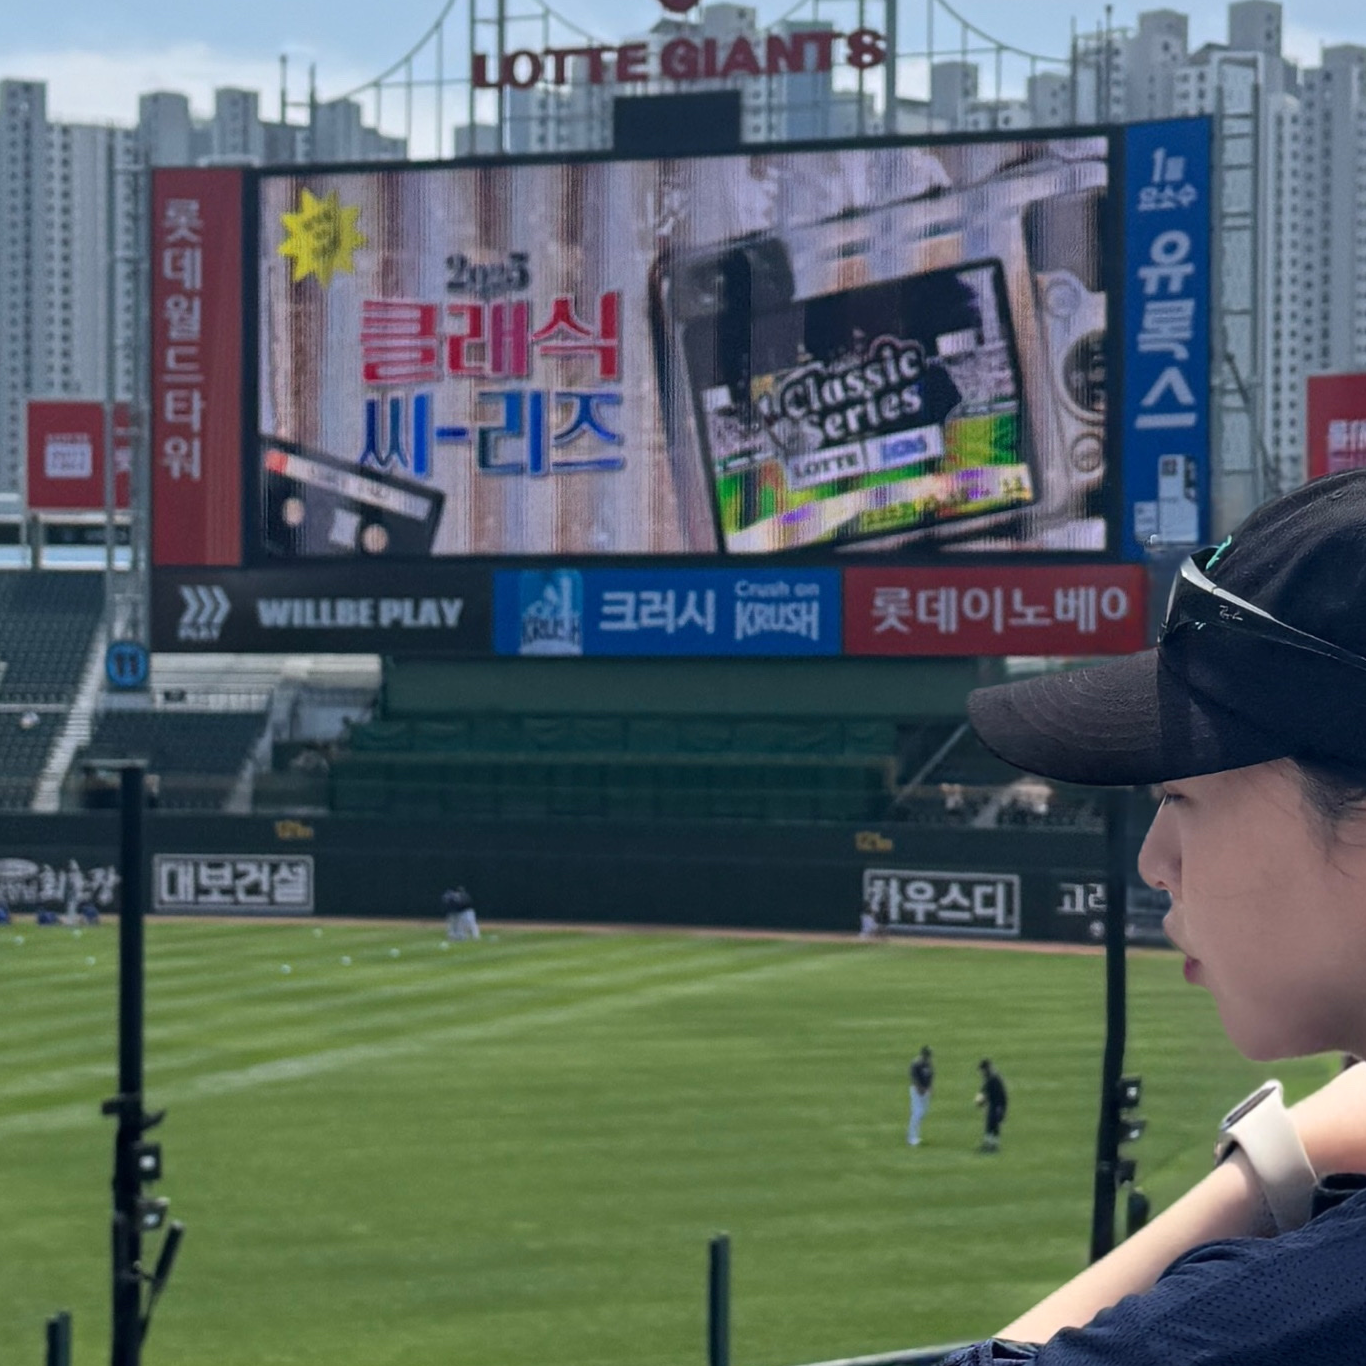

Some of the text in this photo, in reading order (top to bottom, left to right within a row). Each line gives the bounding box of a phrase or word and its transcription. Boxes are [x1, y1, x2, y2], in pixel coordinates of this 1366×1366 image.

[473, 28, 886, 89] LOTTE GIANTS
[161, 198, 207, 481] 롯데월드타워
[361, 290, 621, 384] 클래식
[784, 343, 922, 417] Classic
[256, 598, 465, 629] WILLBE PLAY
[599, 588, 716, 634] 크러시
[735, 599, 820, 641] KRUSH
[159, 860, 308, 905] 대보건설
